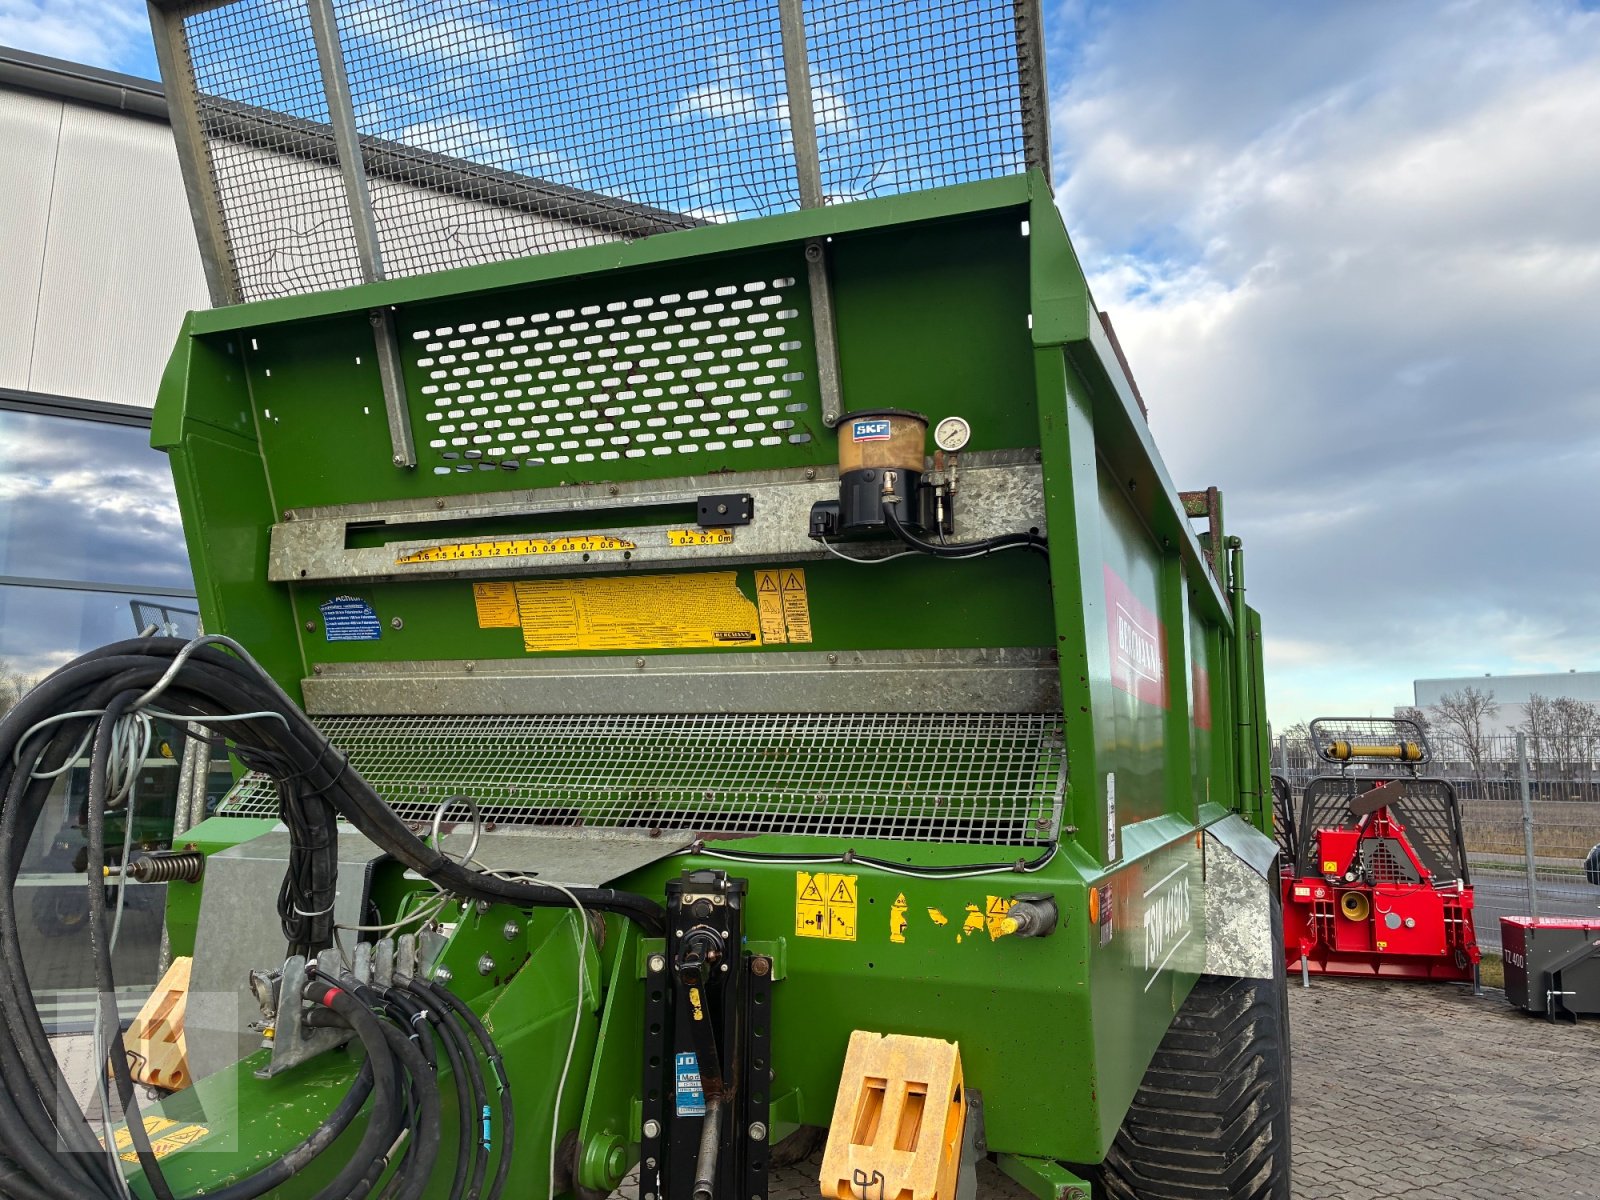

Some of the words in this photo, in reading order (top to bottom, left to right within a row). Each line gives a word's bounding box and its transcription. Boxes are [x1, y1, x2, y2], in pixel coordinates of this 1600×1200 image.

[856, 424, 887, 435] SKF
[680, 536, 694, 544] 0.2
[700, 535, 713, 543] 0.1
[417, 552, 430, 560] 1.6
[435, 551, 447, 559] 1.5
[453, 550, 465, 558] 1.4
[470, 549, 482, 557] 1.3
[488, 548, 501, 556] 1.2
[506, 546, 518, 554] 1.1
[525, 545, 538, 553] 1.0
[543, 544, 556, 552] 0.9
[562, 543, 575, 551] 0.8
[581, 542, 595, 550] 0.7
[600, 541, 614, 549] 0.6
[1143, 897, 1164, 972] TSW
[1184, 876, 1190, 922] S
[1504, 948, 1512, 964] TZ
[1512, 952, 1524, 969] 400
